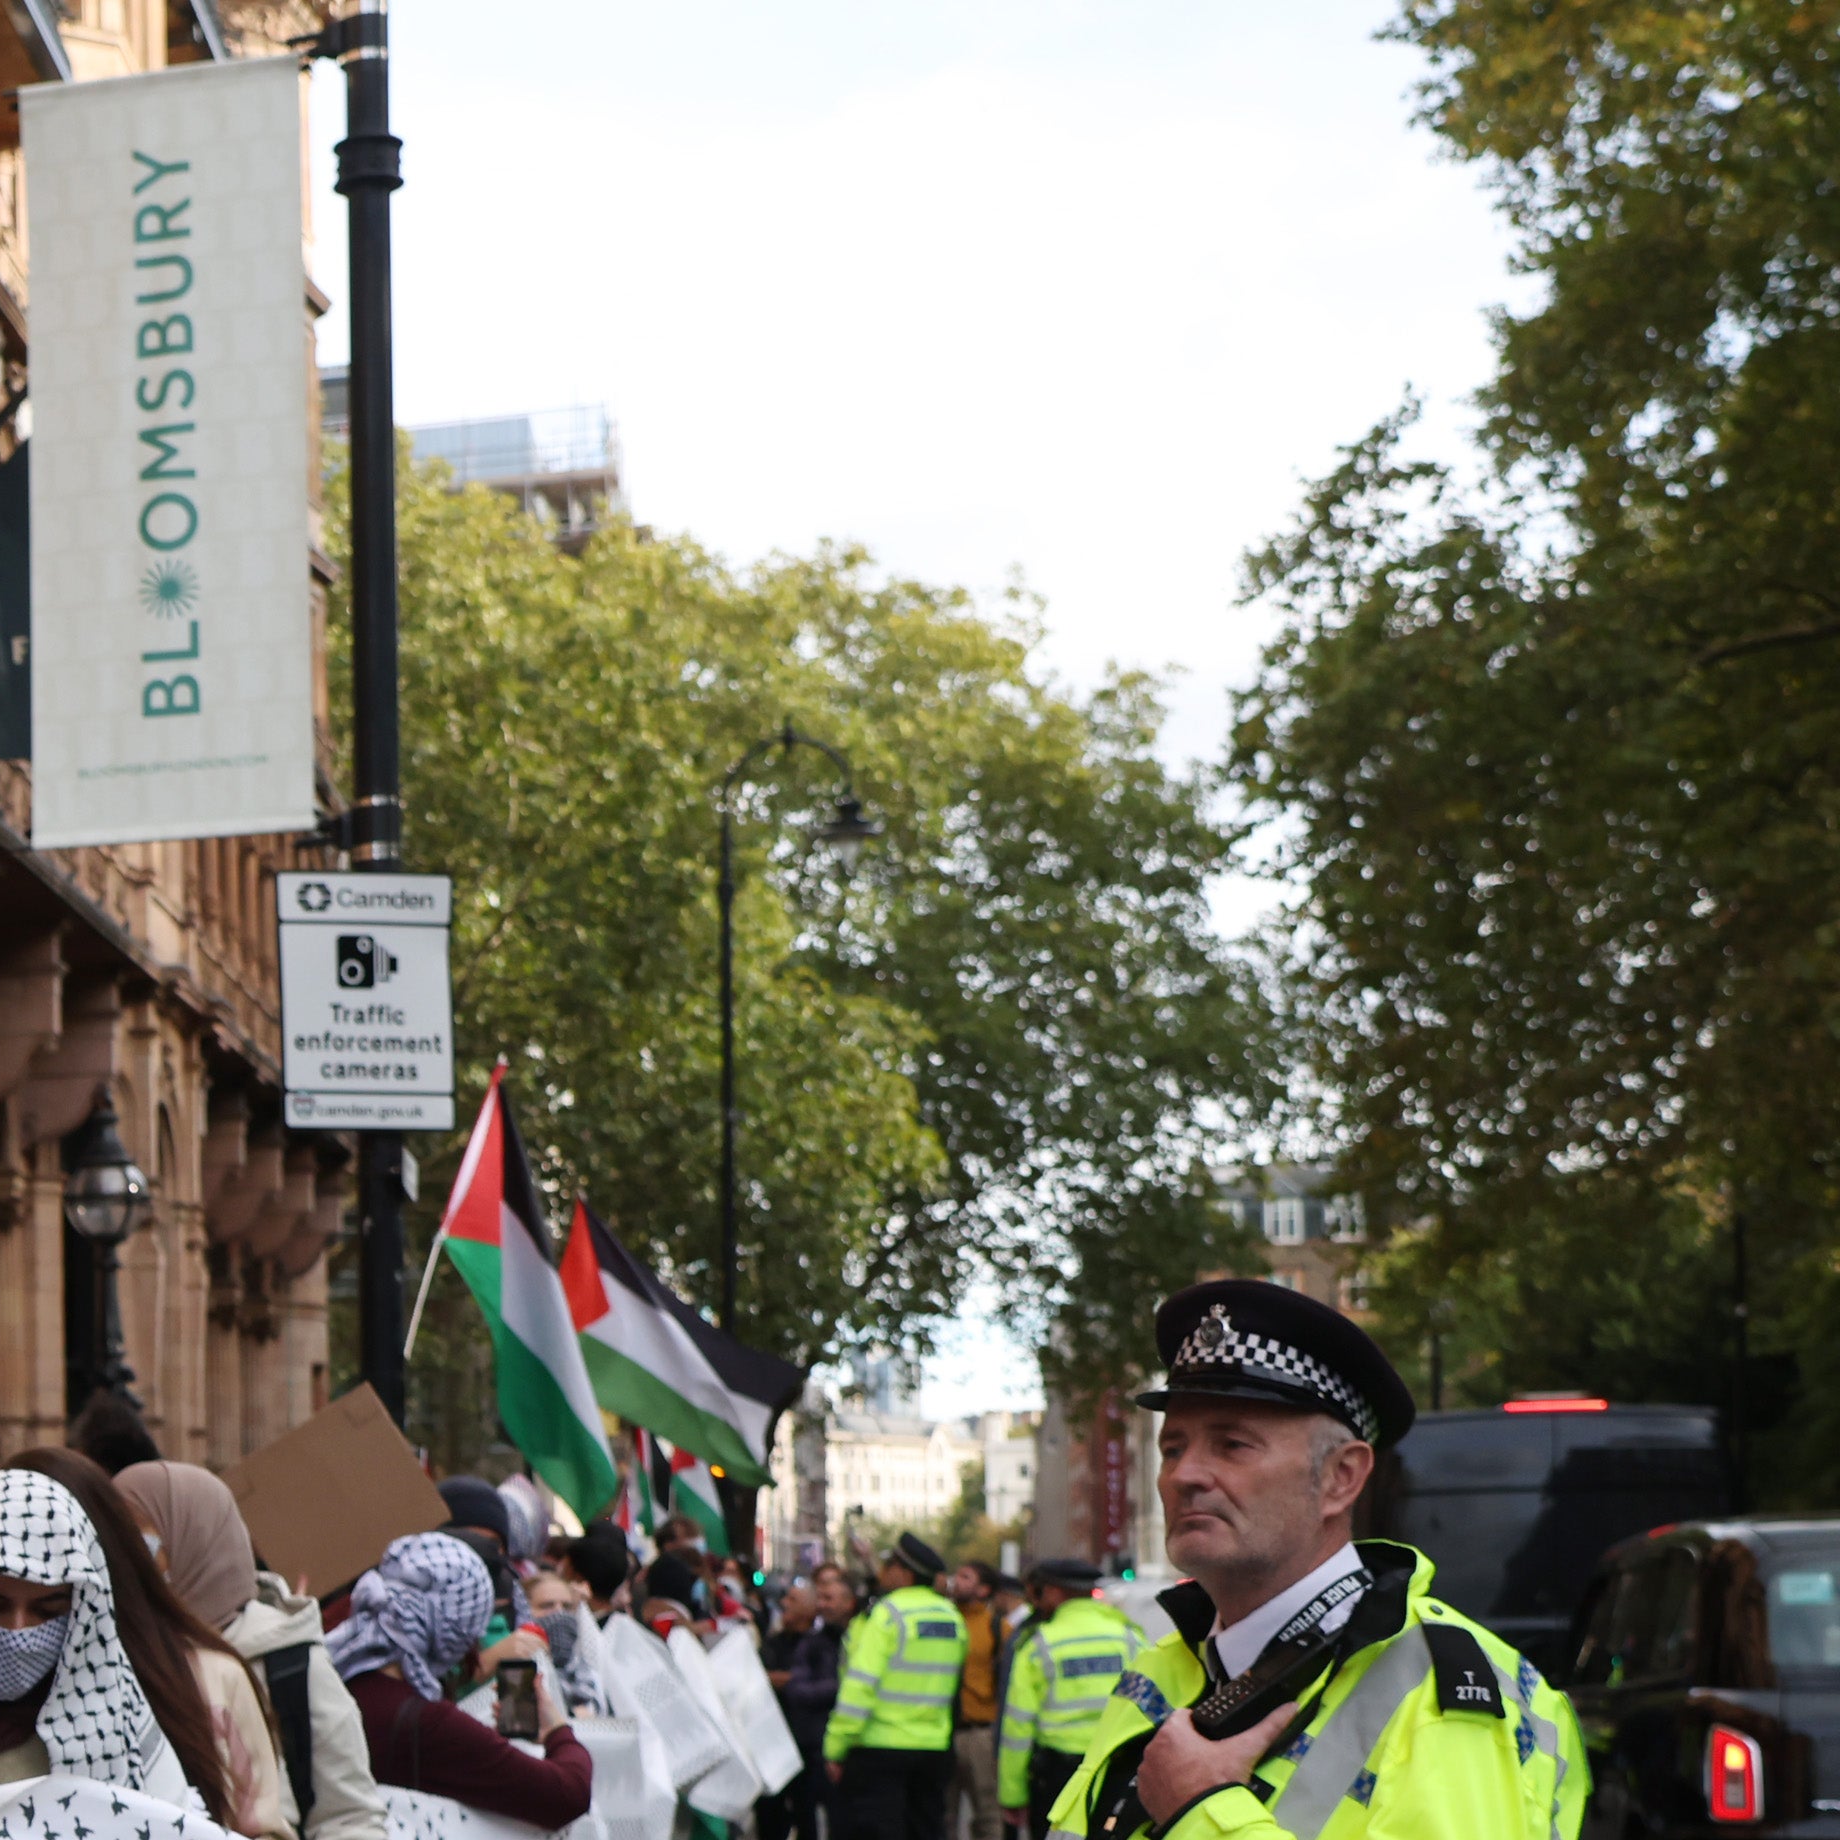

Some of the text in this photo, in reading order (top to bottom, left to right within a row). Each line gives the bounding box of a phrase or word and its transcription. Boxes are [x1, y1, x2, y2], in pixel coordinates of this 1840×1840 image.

[337, 888, 434, 911] Camden
[329, 1003, 406, 1026] Traffic
[295, 1032, 442, 1054] enforcement
[320, 1061, 418, 1081] cameras
[1321, 1575, 1362, 1606] POLICE
[1463, 1671, 1475, 1685] T
